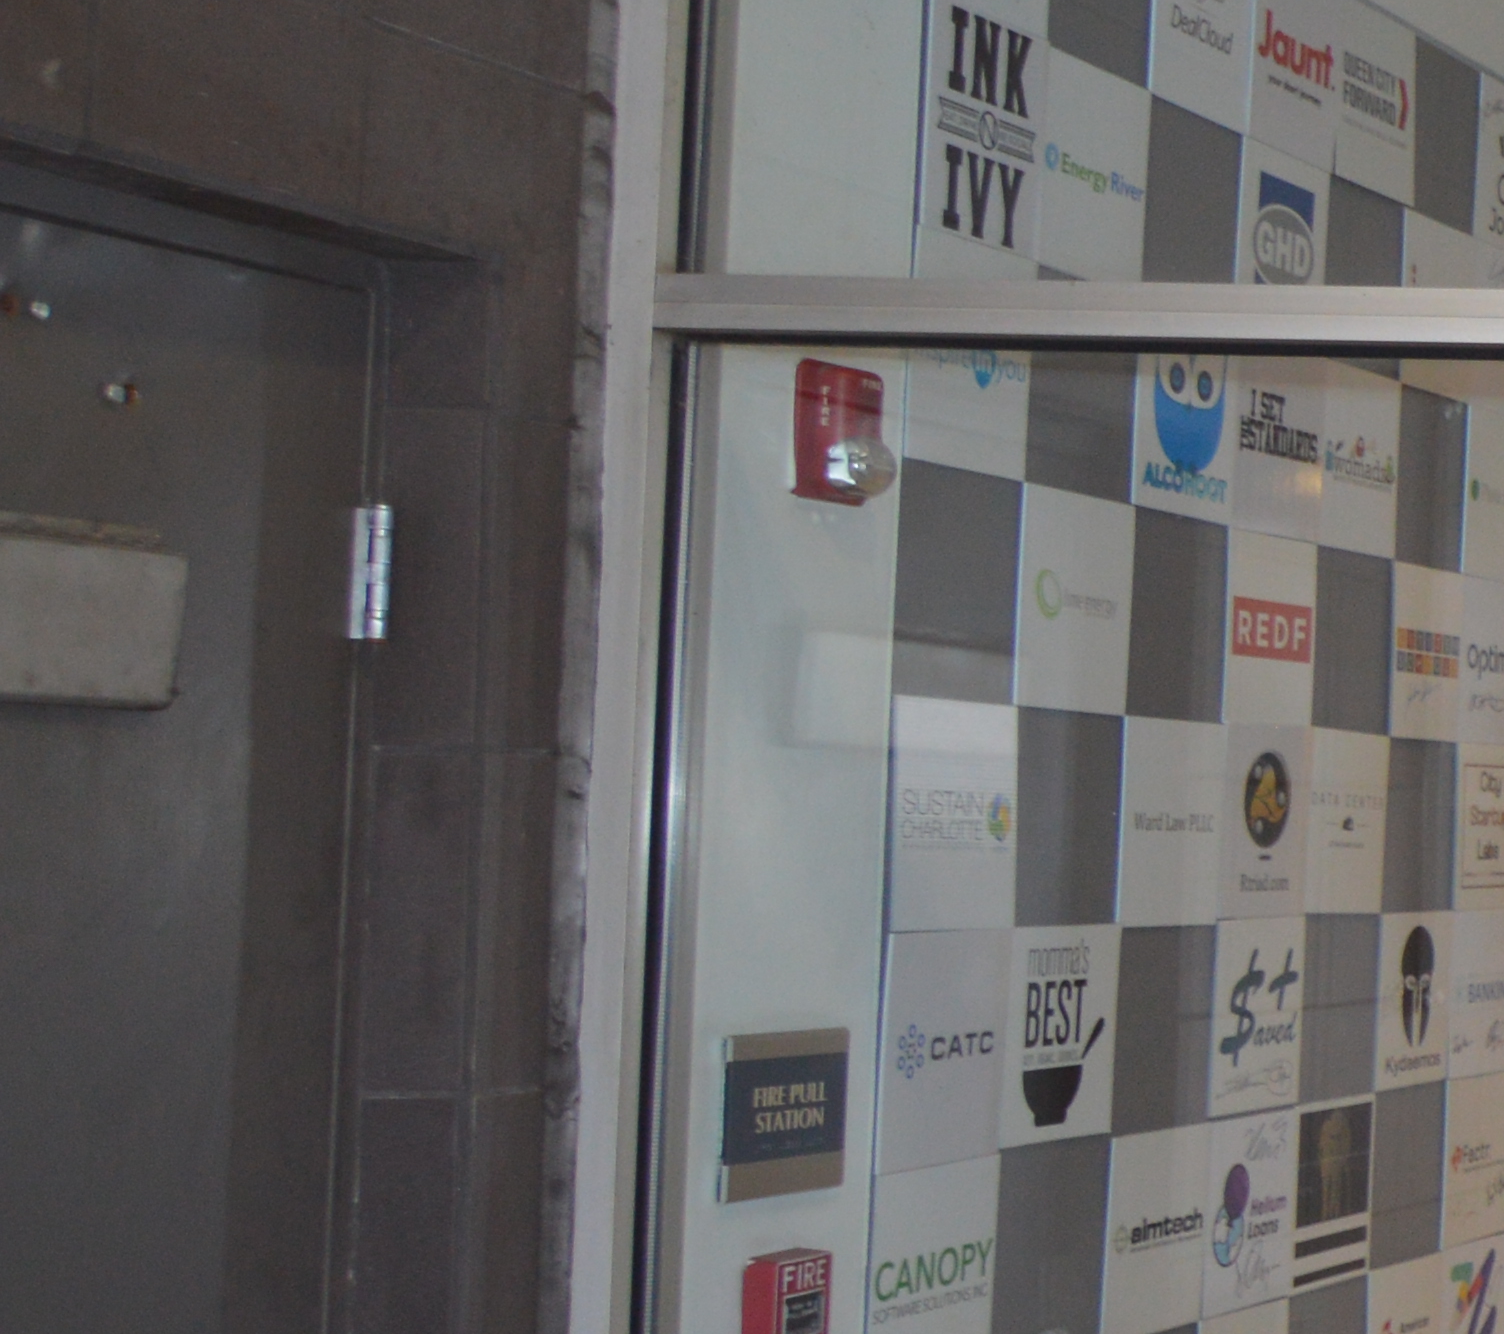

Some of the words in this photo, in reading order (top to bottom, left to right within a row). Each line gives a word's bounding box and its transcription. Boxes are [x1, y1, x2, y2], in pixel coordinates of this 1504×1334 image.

[1170, 5, 1235, 56] DealCloud
[948, 5, 1032, 119] INK
[942, 144, 1025, 249] IVY
[1061, 153, 1109, 194] Energy
[1110, 171, 1145, 203] River
[1237, 610, 1307, 653] REDF
[902, 788, 984, 816] SUSTAIN
[1134, 812, 1163, 830] Ward
[1165, 814, 1187, 832] Law
[1025, 978, 1089, 1049] BEST
[930, 1030, 994, 1060] CATC
[753, 1085, 786, 1108] FIRE
[789, 1080, 829, 1105] PULL
[754, 1106, 825, 1134] STATION
[1131, 1208, 1205, 1245] aimtech
[780, 1259, 828, 1293] FIRE
[875, 1238, 994, 1302] CANOPY
